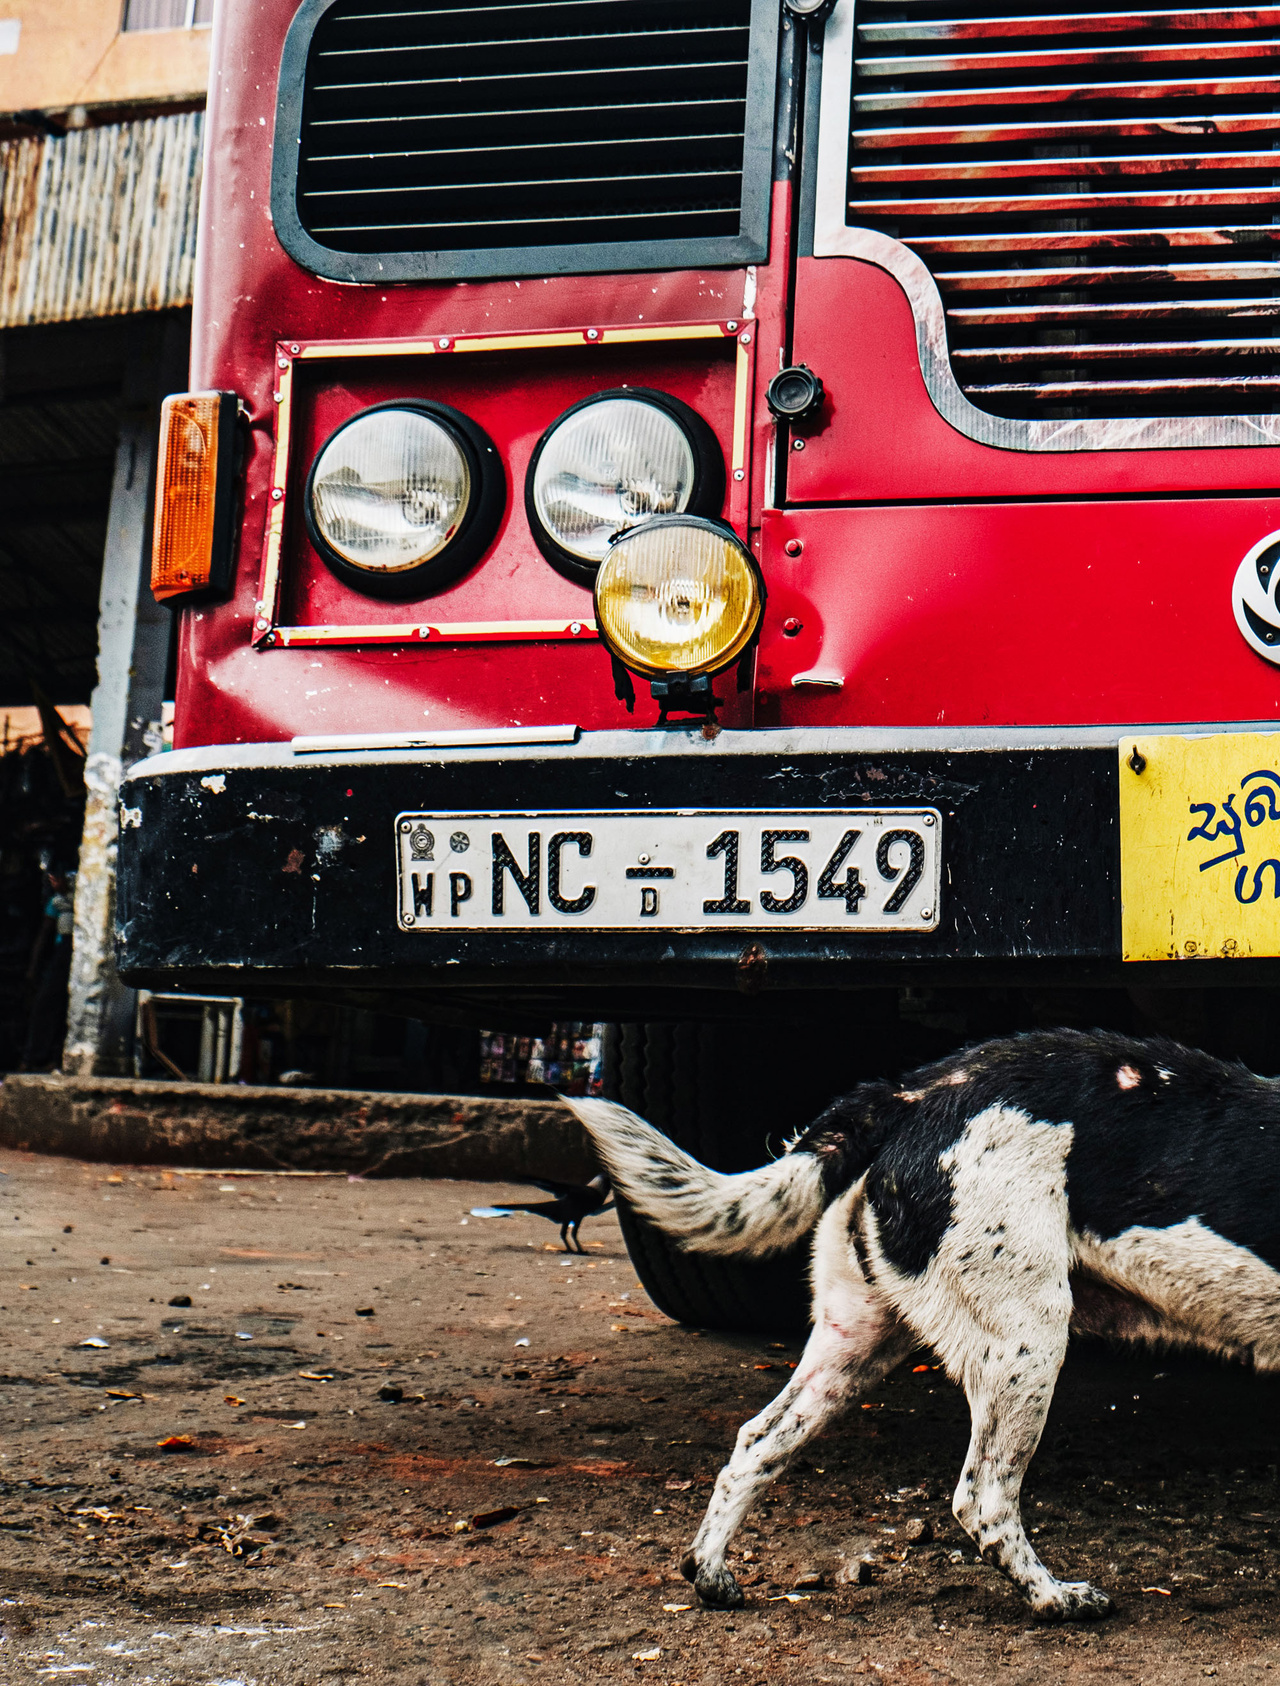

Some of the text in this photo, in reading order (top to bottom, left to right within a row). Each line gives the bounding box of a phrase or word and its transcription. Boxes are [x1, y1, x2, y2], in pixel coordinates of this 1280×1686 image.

[491, 831, 597, 916] NC
[702, 830, 926, 915] 1549
[640, 887, 658, 916] D
